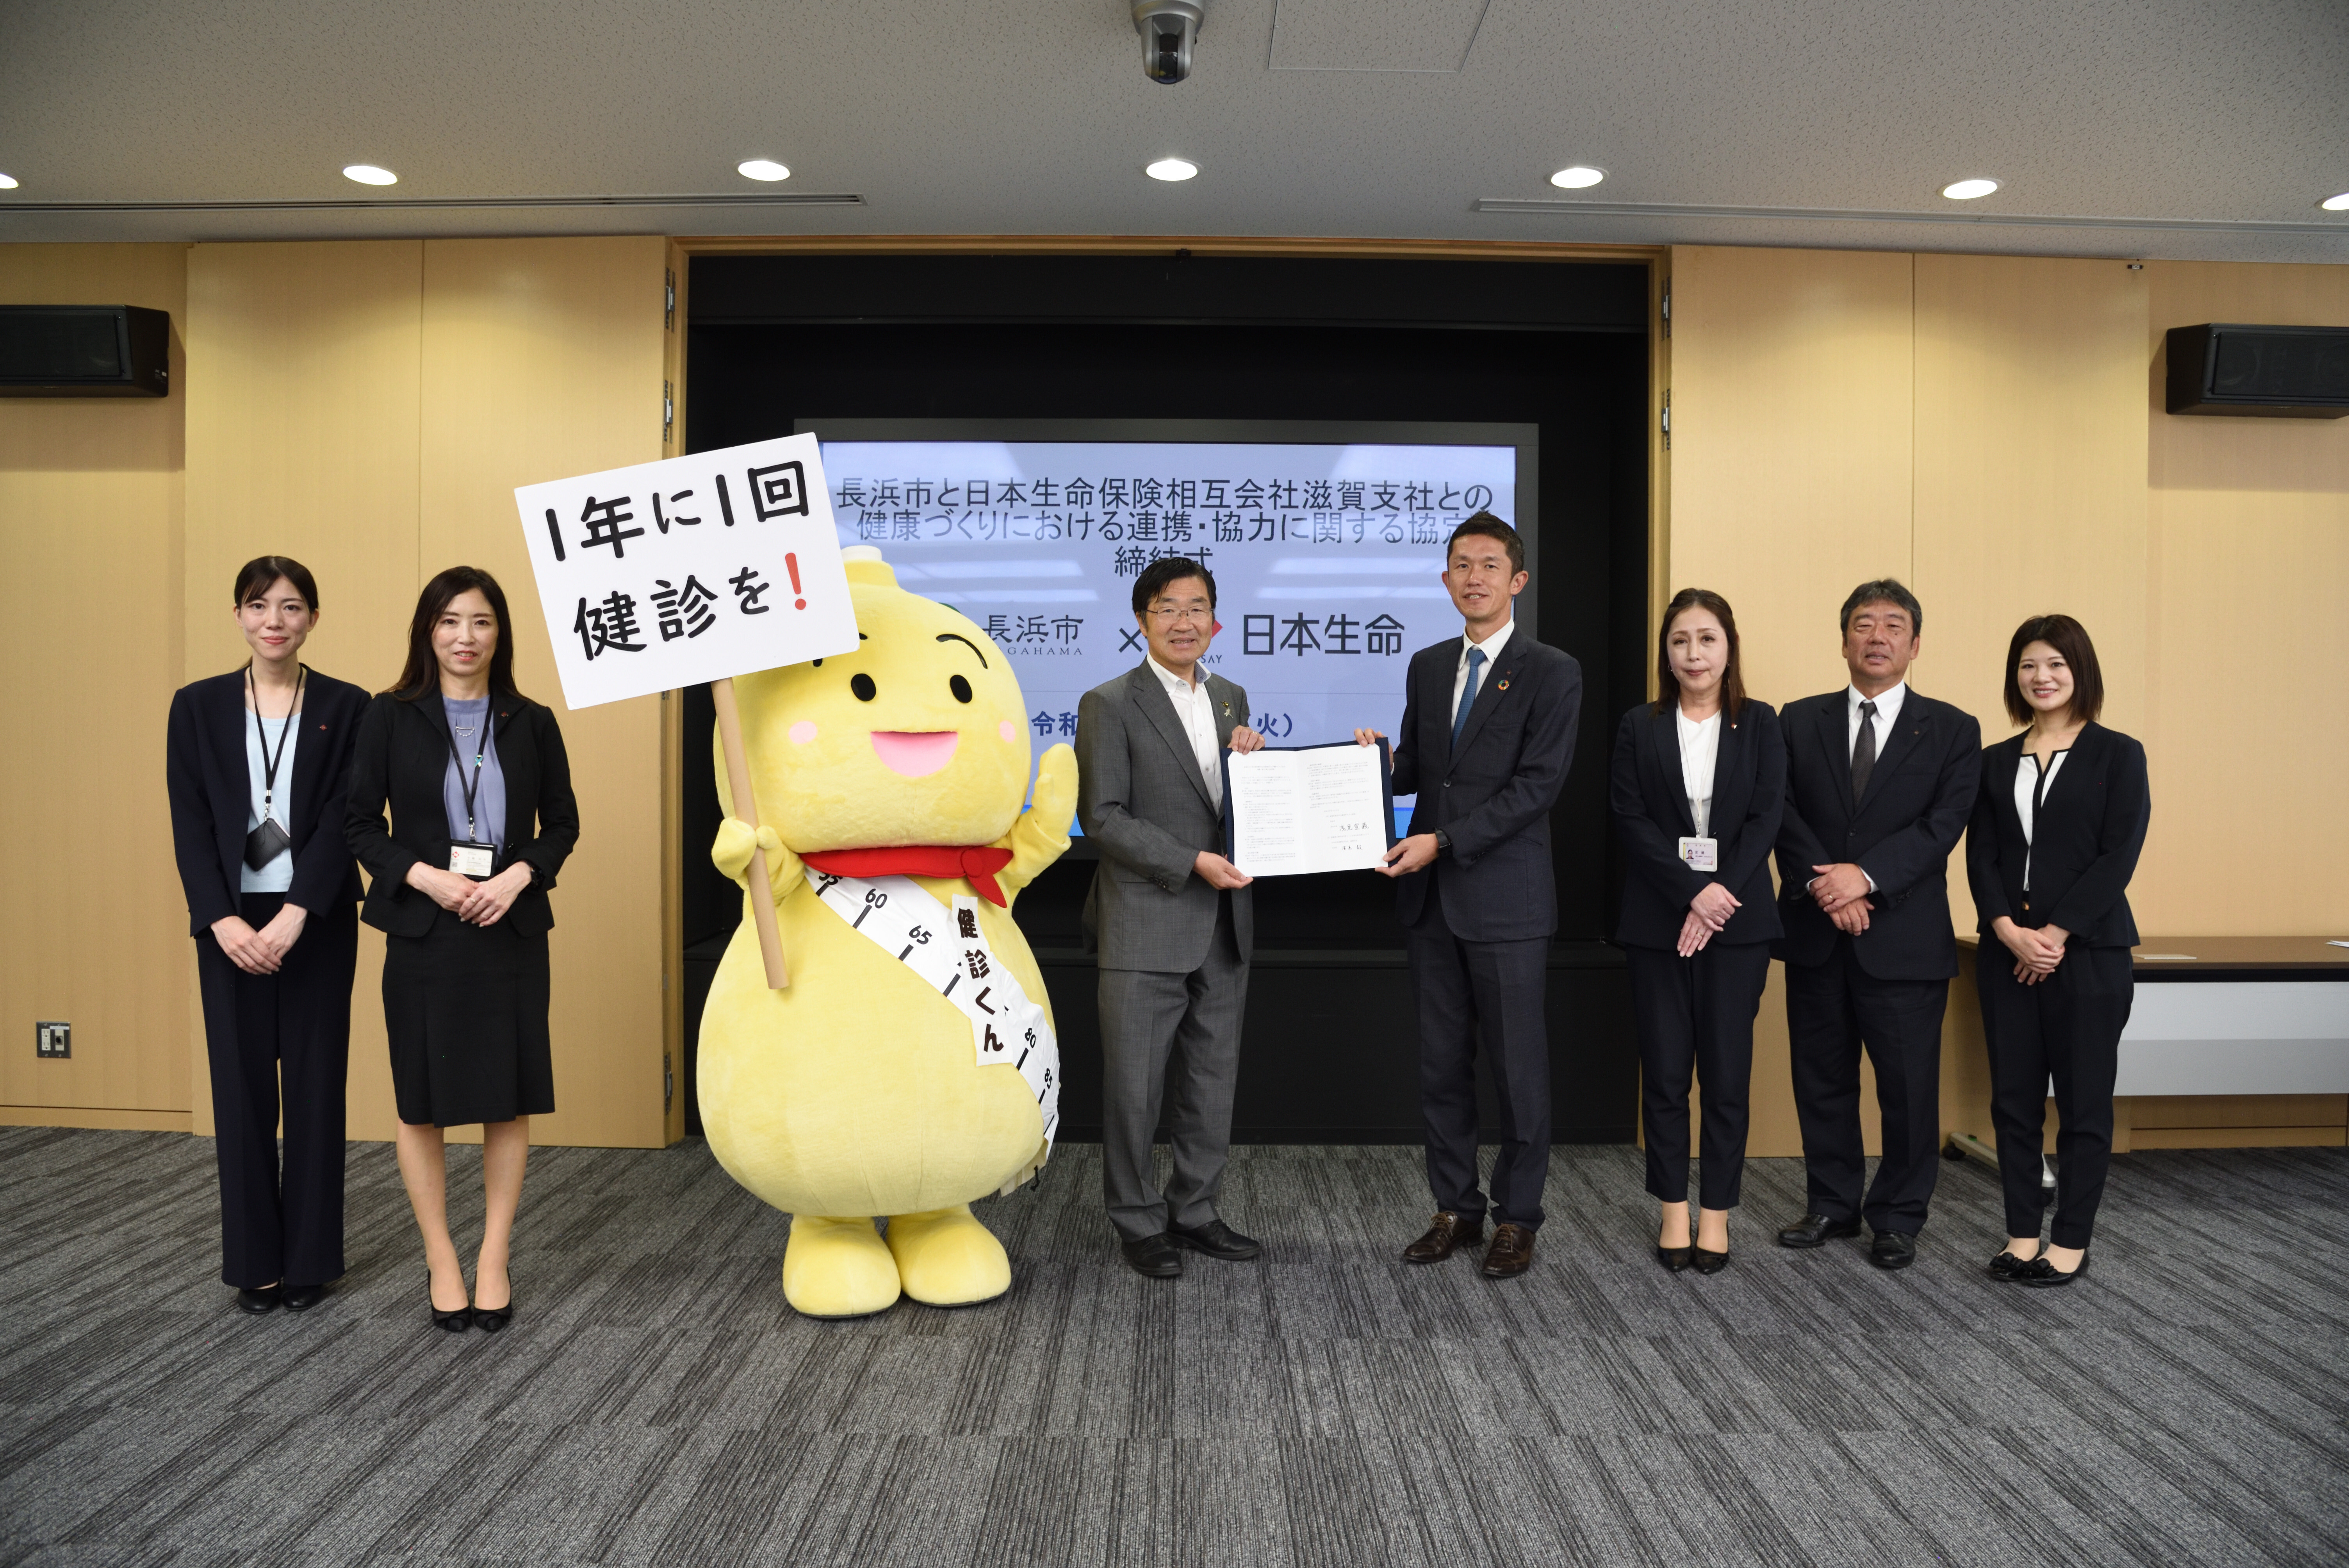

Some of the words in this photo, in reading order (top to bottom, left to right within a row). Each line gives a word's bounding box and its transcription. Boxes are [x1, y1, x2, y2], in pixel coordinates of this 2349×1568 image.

[545, 460, 809, 561] 1年に1回
[836, 477, 1493, 511] 長浜市と日本生命保険相互会社滋賀支社との
[982, 615, 1084, 645] 長浜市
[1243, 612, 1405, 656] 日本生命
[998, 647, 1082, 655] GAHAMA
[1201, 654, 1223, 664] SAY
[865, 888, 888, 909] 60
[909, 925, 932, 945] 65
[1025, 1028, 1036, 1048] 80
[1044, 1068, 1053, 1089] 85
[957, 908, 1004, 1052] 健診くん
